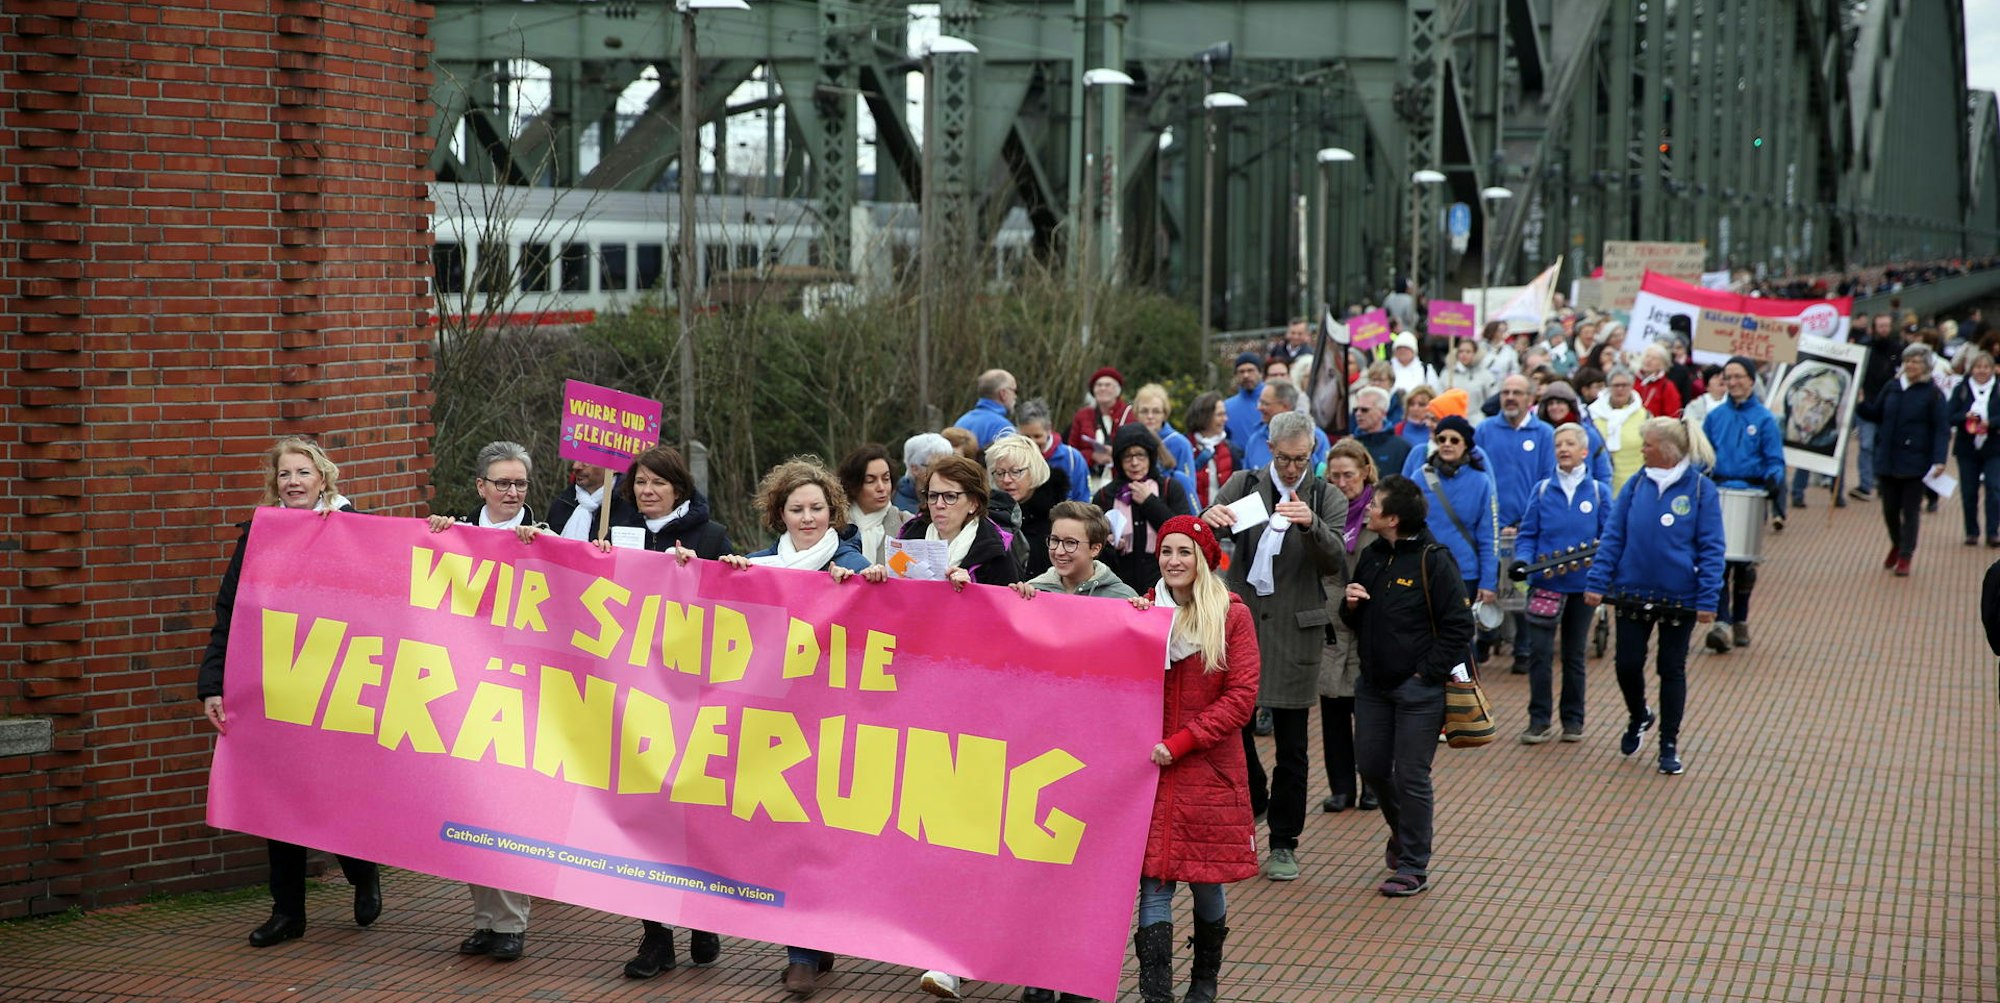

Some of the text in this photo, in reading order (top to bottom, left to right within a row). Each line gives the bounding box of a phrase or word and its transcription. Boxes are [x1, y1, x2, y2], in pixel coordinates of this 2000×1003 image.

[1729, 339, 1776, 360] SEELE
[569, 398, 646, 431] WÜRDE UND
[409, 546, 898, 692] WIR SIND DIE
[262, 608, 1087, 865] VERÄNDERUNG
[446, 827, 494, 846] Catholic
[558, 851, 607, 870] Council
[616, 864, 646, 878] viele
[648, 870, 707, 891] Stimmen,
[709, 881, 735, 895] eine
[737, 886, 775, 902] Vision
